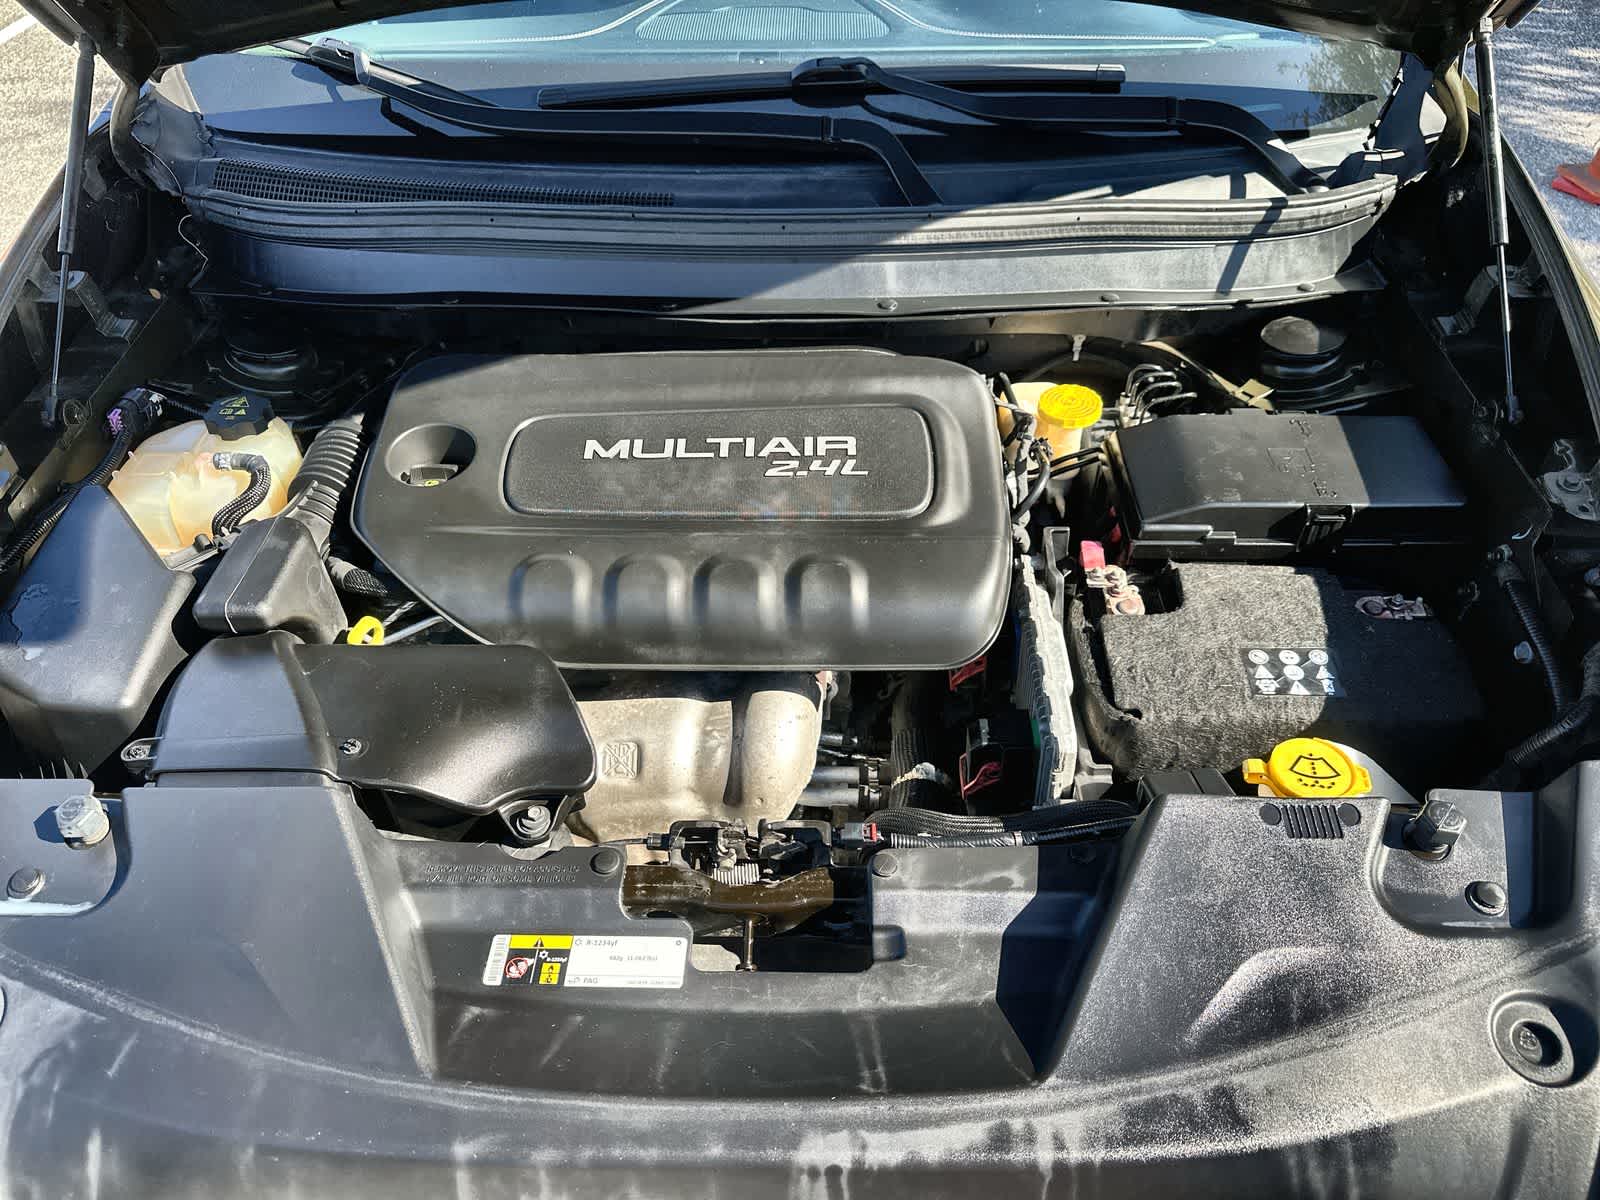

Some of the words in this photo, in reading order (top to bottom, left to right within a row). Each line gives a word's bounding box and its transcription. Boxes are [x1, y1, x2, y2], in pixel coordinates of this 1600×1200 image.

[583, 436, 857, 460] MULTIAIR
[763, 459, 869, 478] 2.4L
[585, 939, 618, 947] R-1234yf
